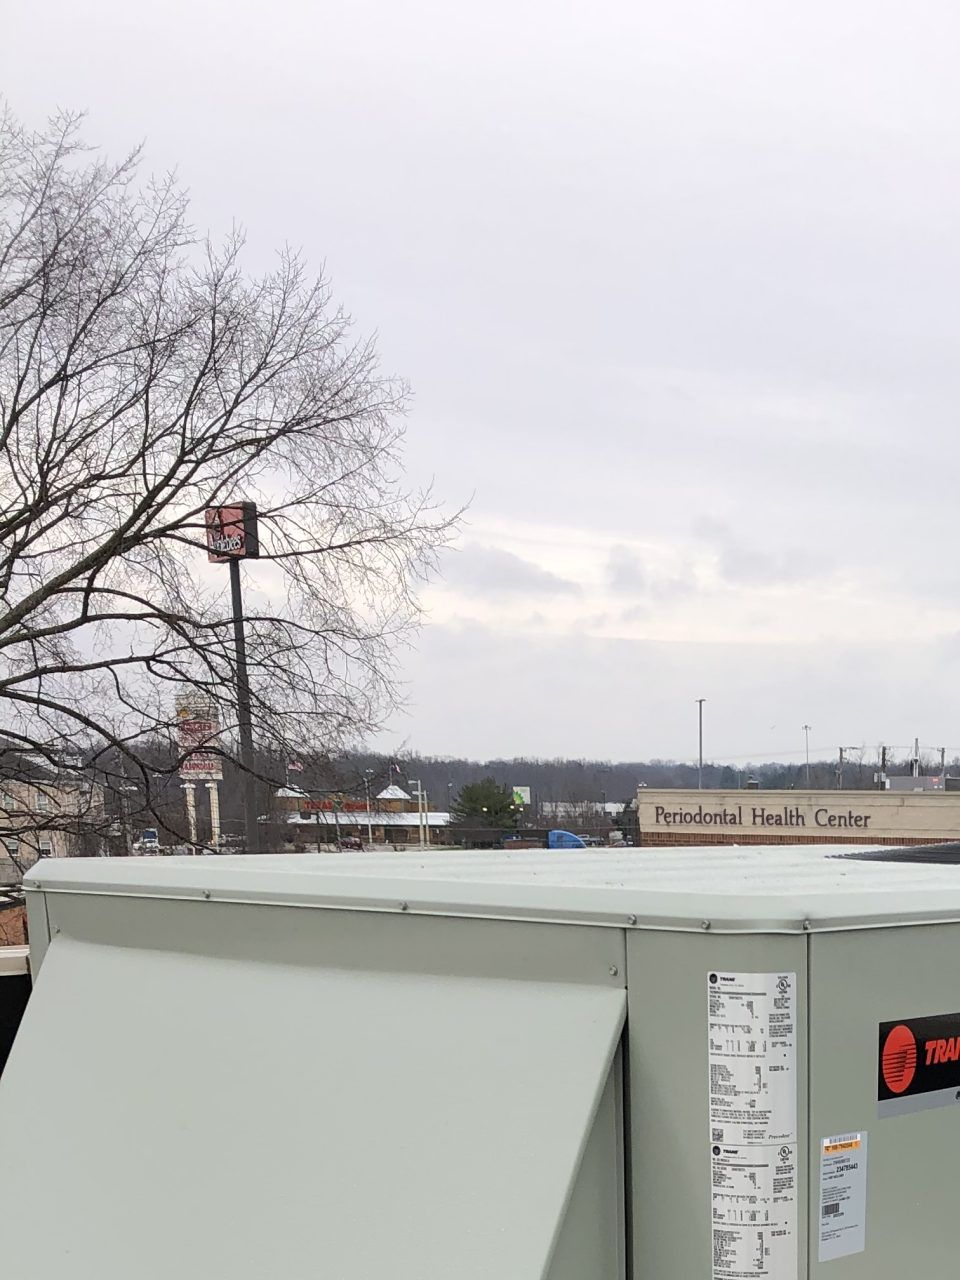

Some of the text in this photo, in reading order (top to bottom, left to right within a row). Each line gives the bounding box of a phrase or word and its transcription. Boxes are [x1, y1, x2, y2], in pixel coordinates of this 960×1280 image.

[655, 805, 872, 828] Periodontal Health Center
